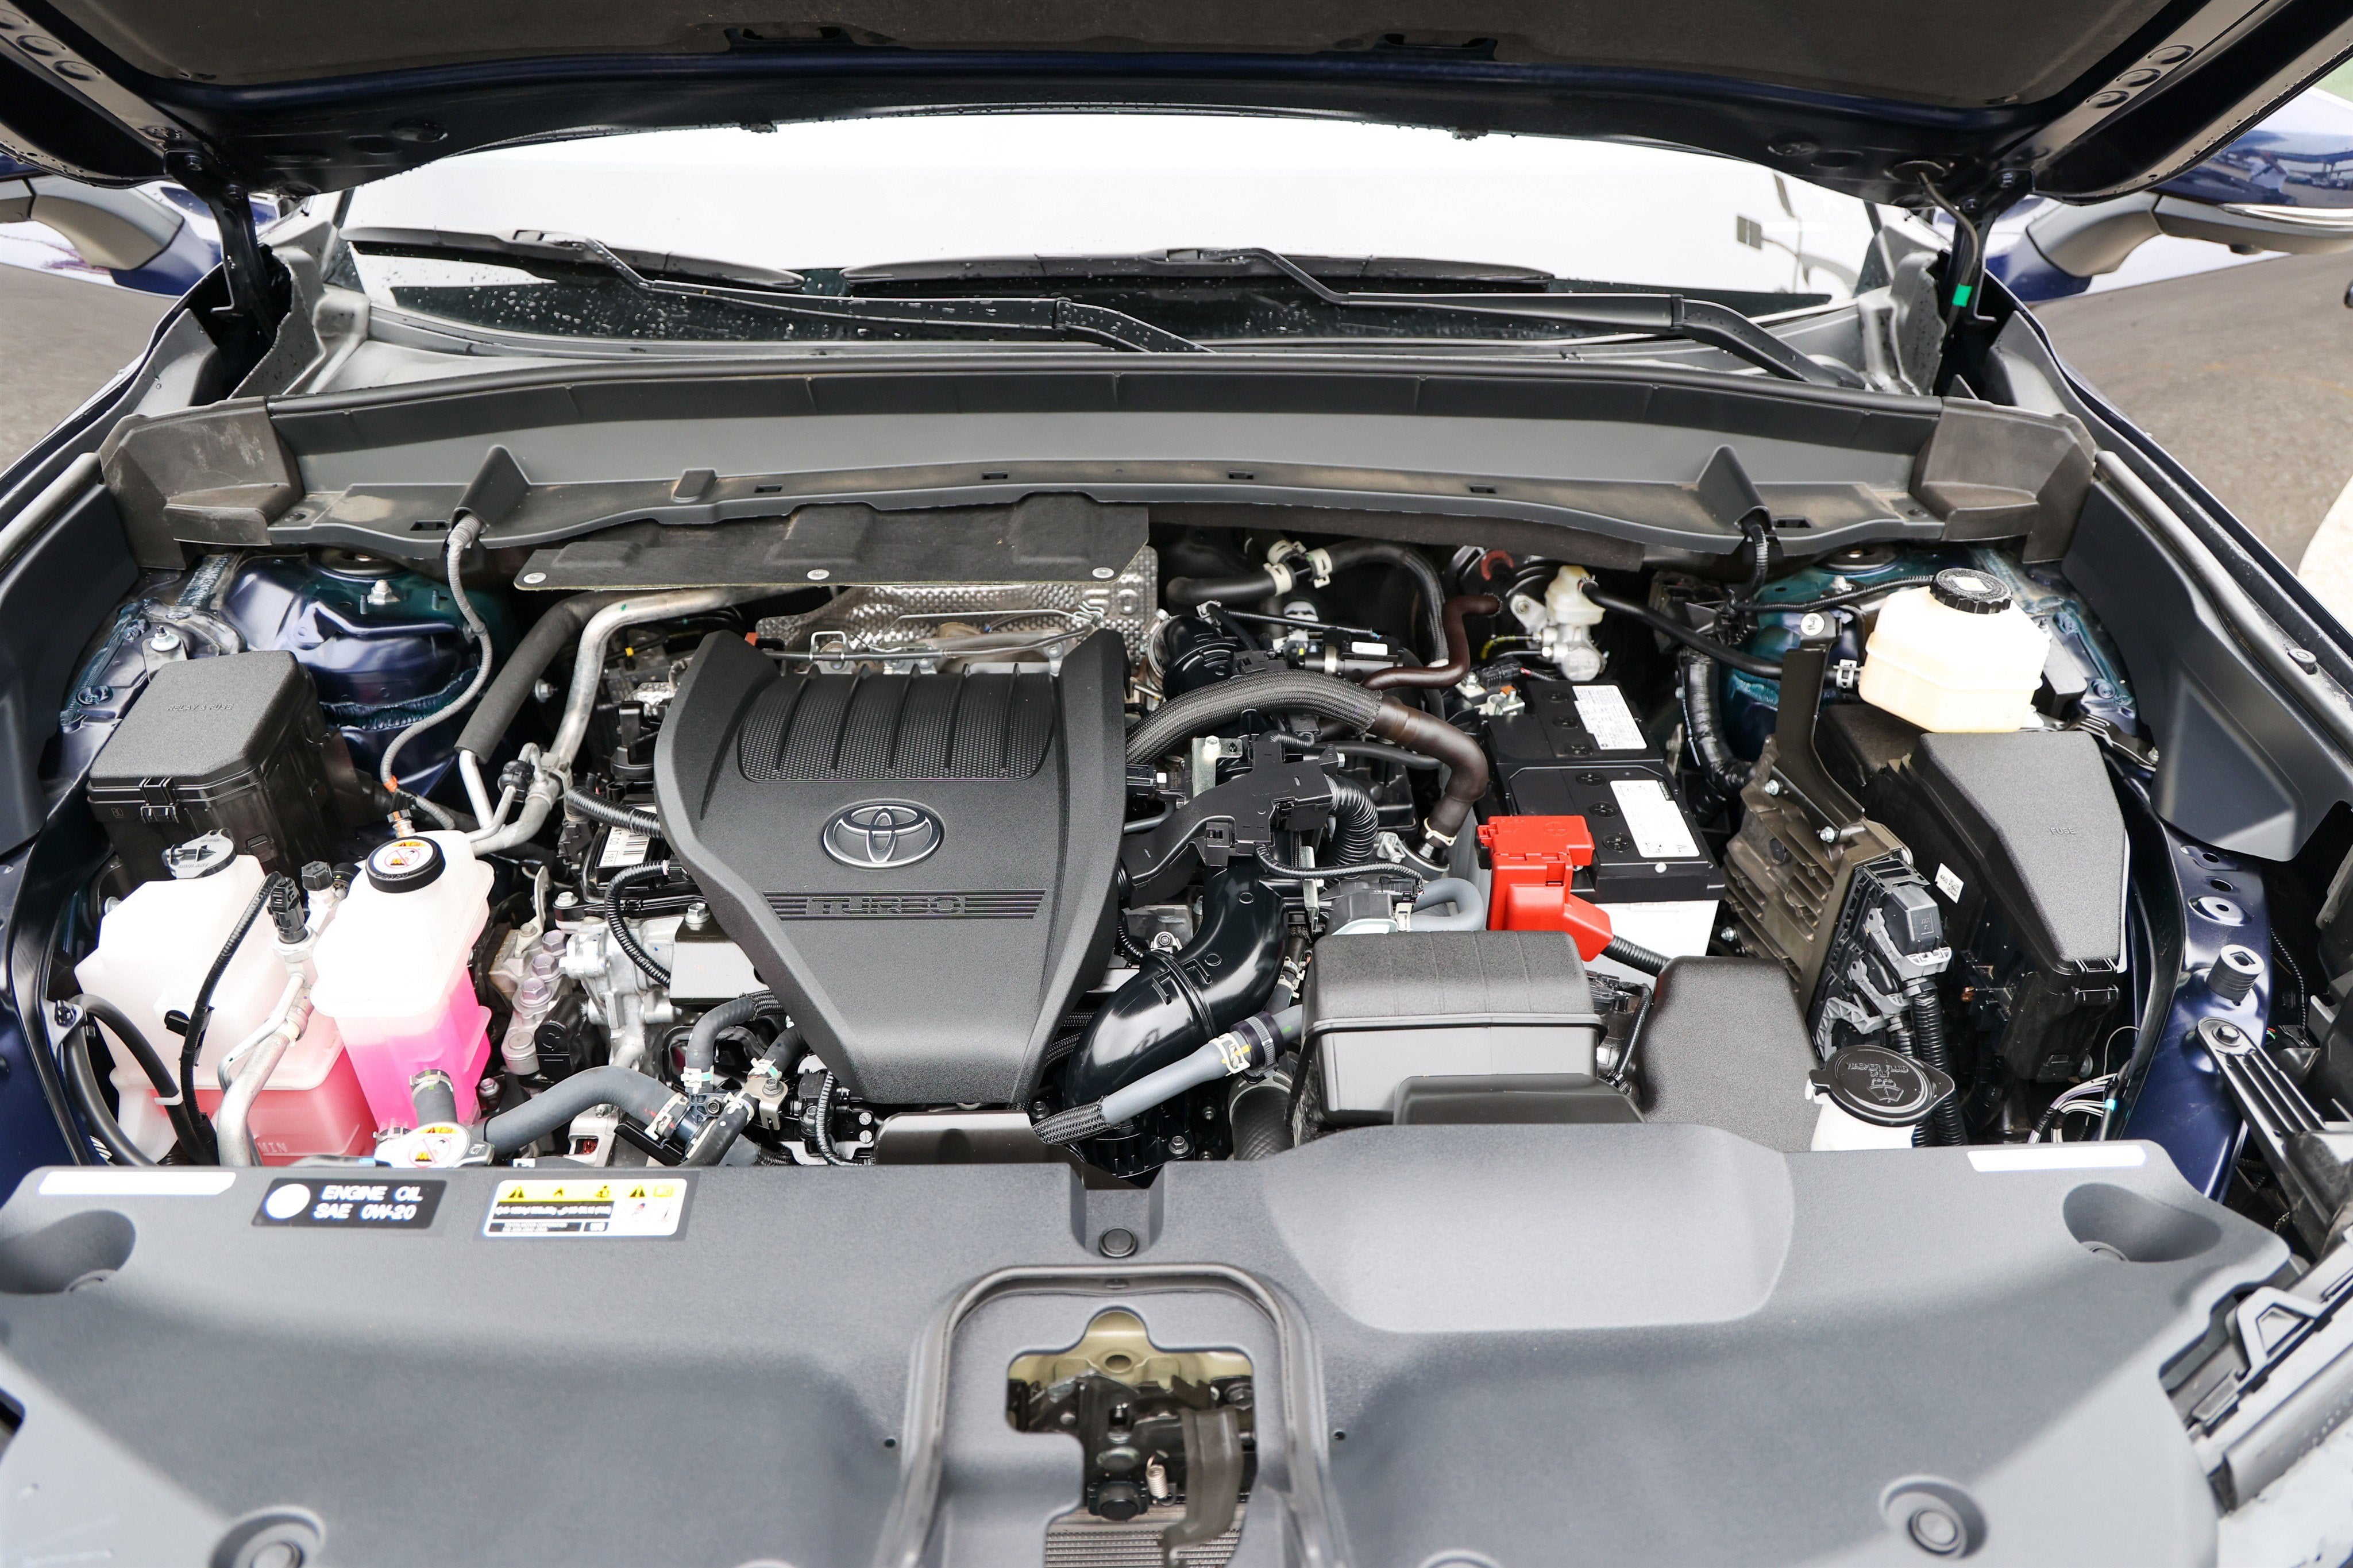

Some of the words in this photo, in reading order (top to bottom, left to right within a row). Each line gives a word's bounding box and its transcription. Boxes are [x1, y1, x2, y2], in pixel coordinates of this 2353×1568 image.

[2050, 827, 2077, 835] FUSE
[811, 895, 962, 914] TURBO
[1846, 1062, 1881, 1071] WASHER
[1885, 1064, 1909, 1073] FLUID
[1870, 1070, 1890, 1078] ONLY
[256, 1142, 288, 1153] MIN
[321, 1185, 388, 1202] ENGINE
[394, 1185, 423, 1202] OIL
[313, 1203, 353, 1220] SAE
[360, 1204, 417, 1221] 0W-20
